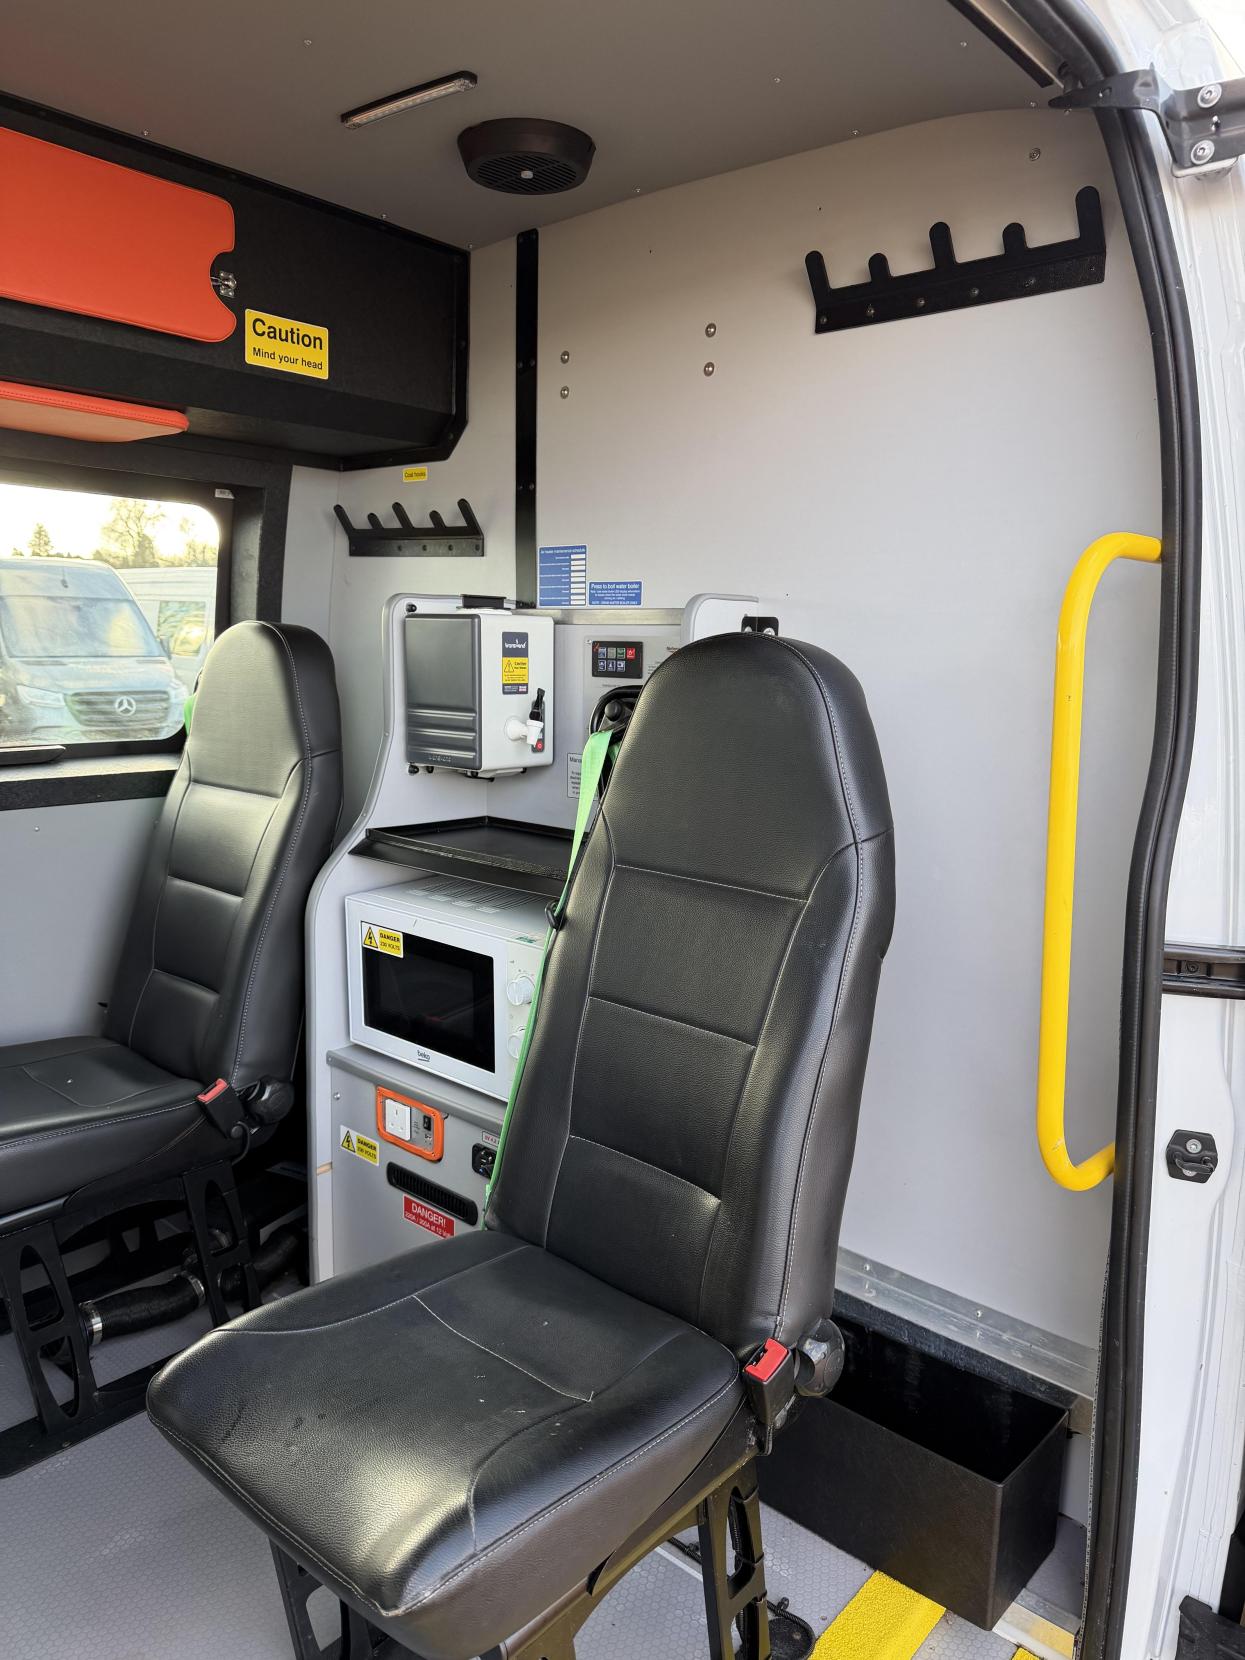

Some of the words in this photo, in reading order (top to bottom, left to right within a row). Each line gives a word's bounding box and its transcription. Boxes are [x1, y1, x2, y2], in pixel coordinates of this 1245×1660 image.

[252, 317, 323, 350] Caution
[252, 346, 276, 360] Mind
[278, 354, 299, 364] your
[301, 357, 323, 370] head
[380, 932, 400, 942] DANGER
[417, 1049, 431, 1060] beko
[357, 1138, 377, 1151] DANGER
[411, 1201, 446, 1228] DANGER!
